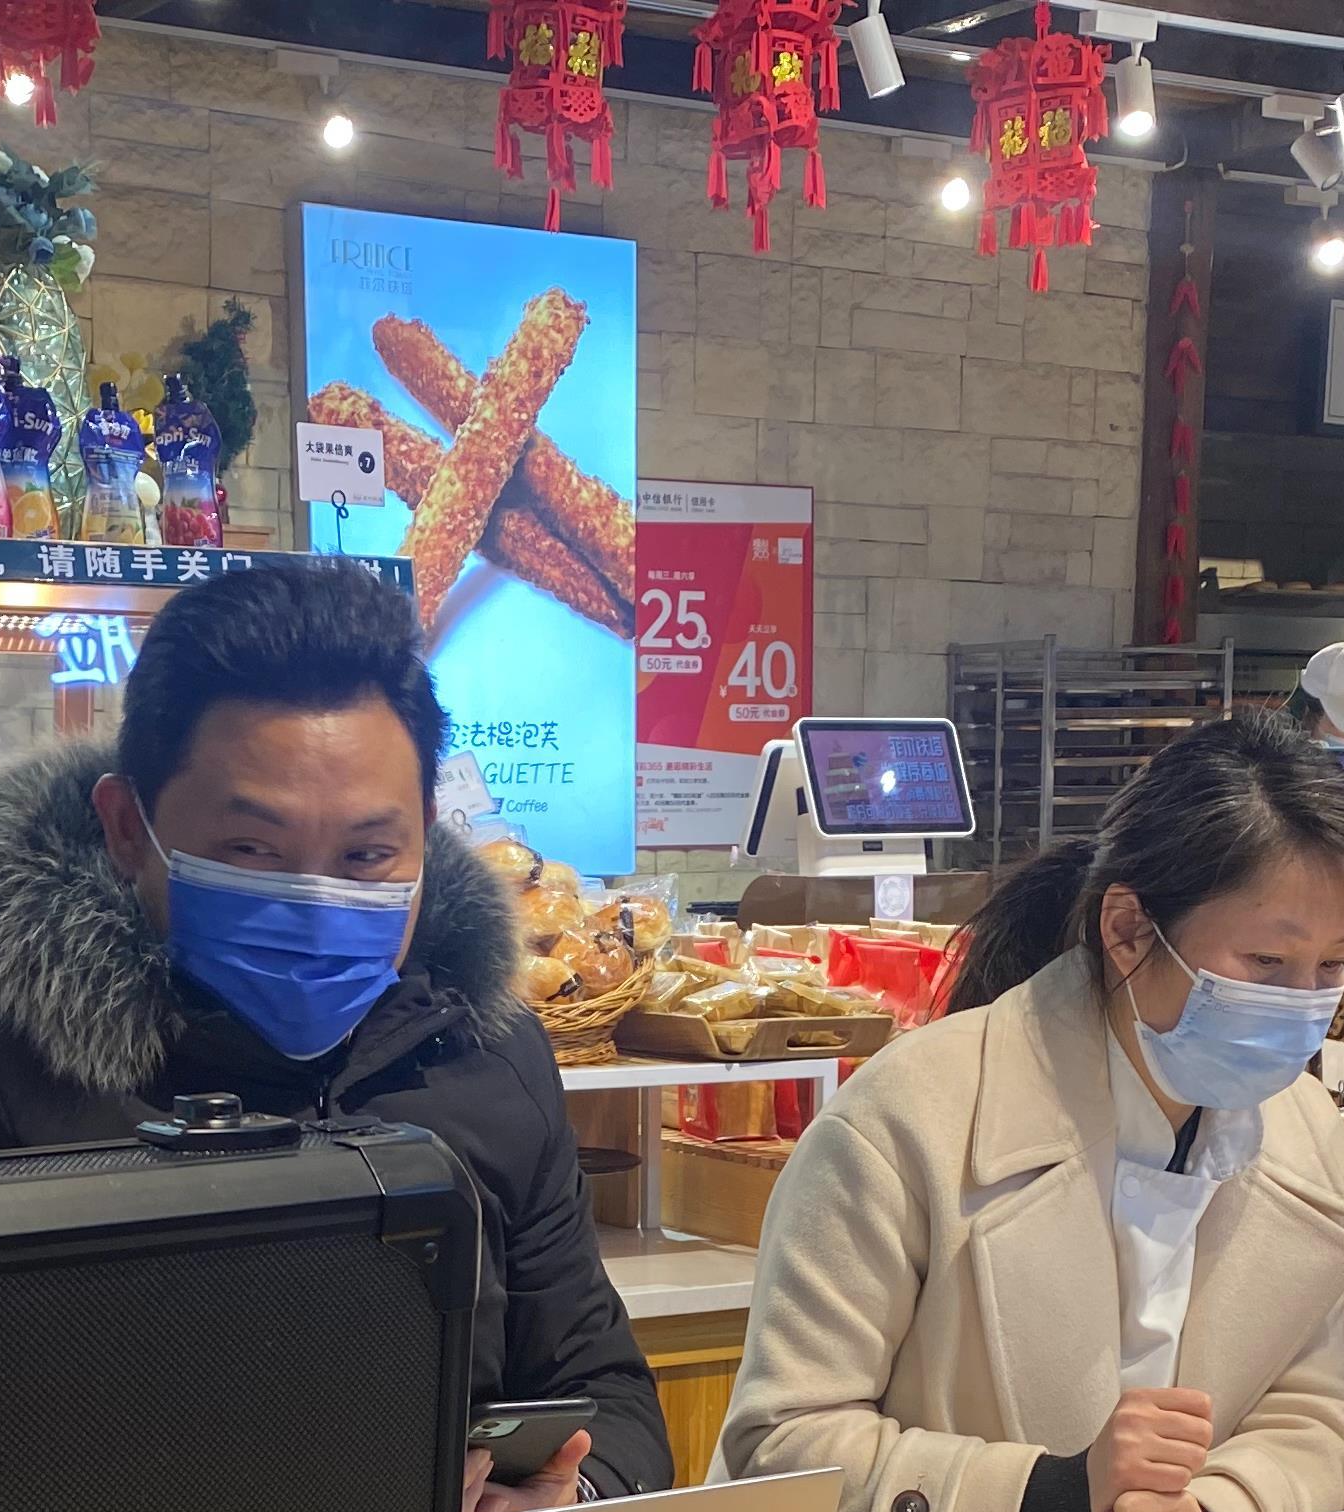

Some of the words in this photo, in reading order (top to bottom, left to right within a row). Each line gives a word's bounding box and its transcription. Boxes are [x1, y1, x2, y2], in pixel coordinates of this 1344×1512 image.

[155, 427, 212, 447] apri-Sun
[484, 762, 575, 785] GUETTE
[506, 799, 549, 814] Coffee
